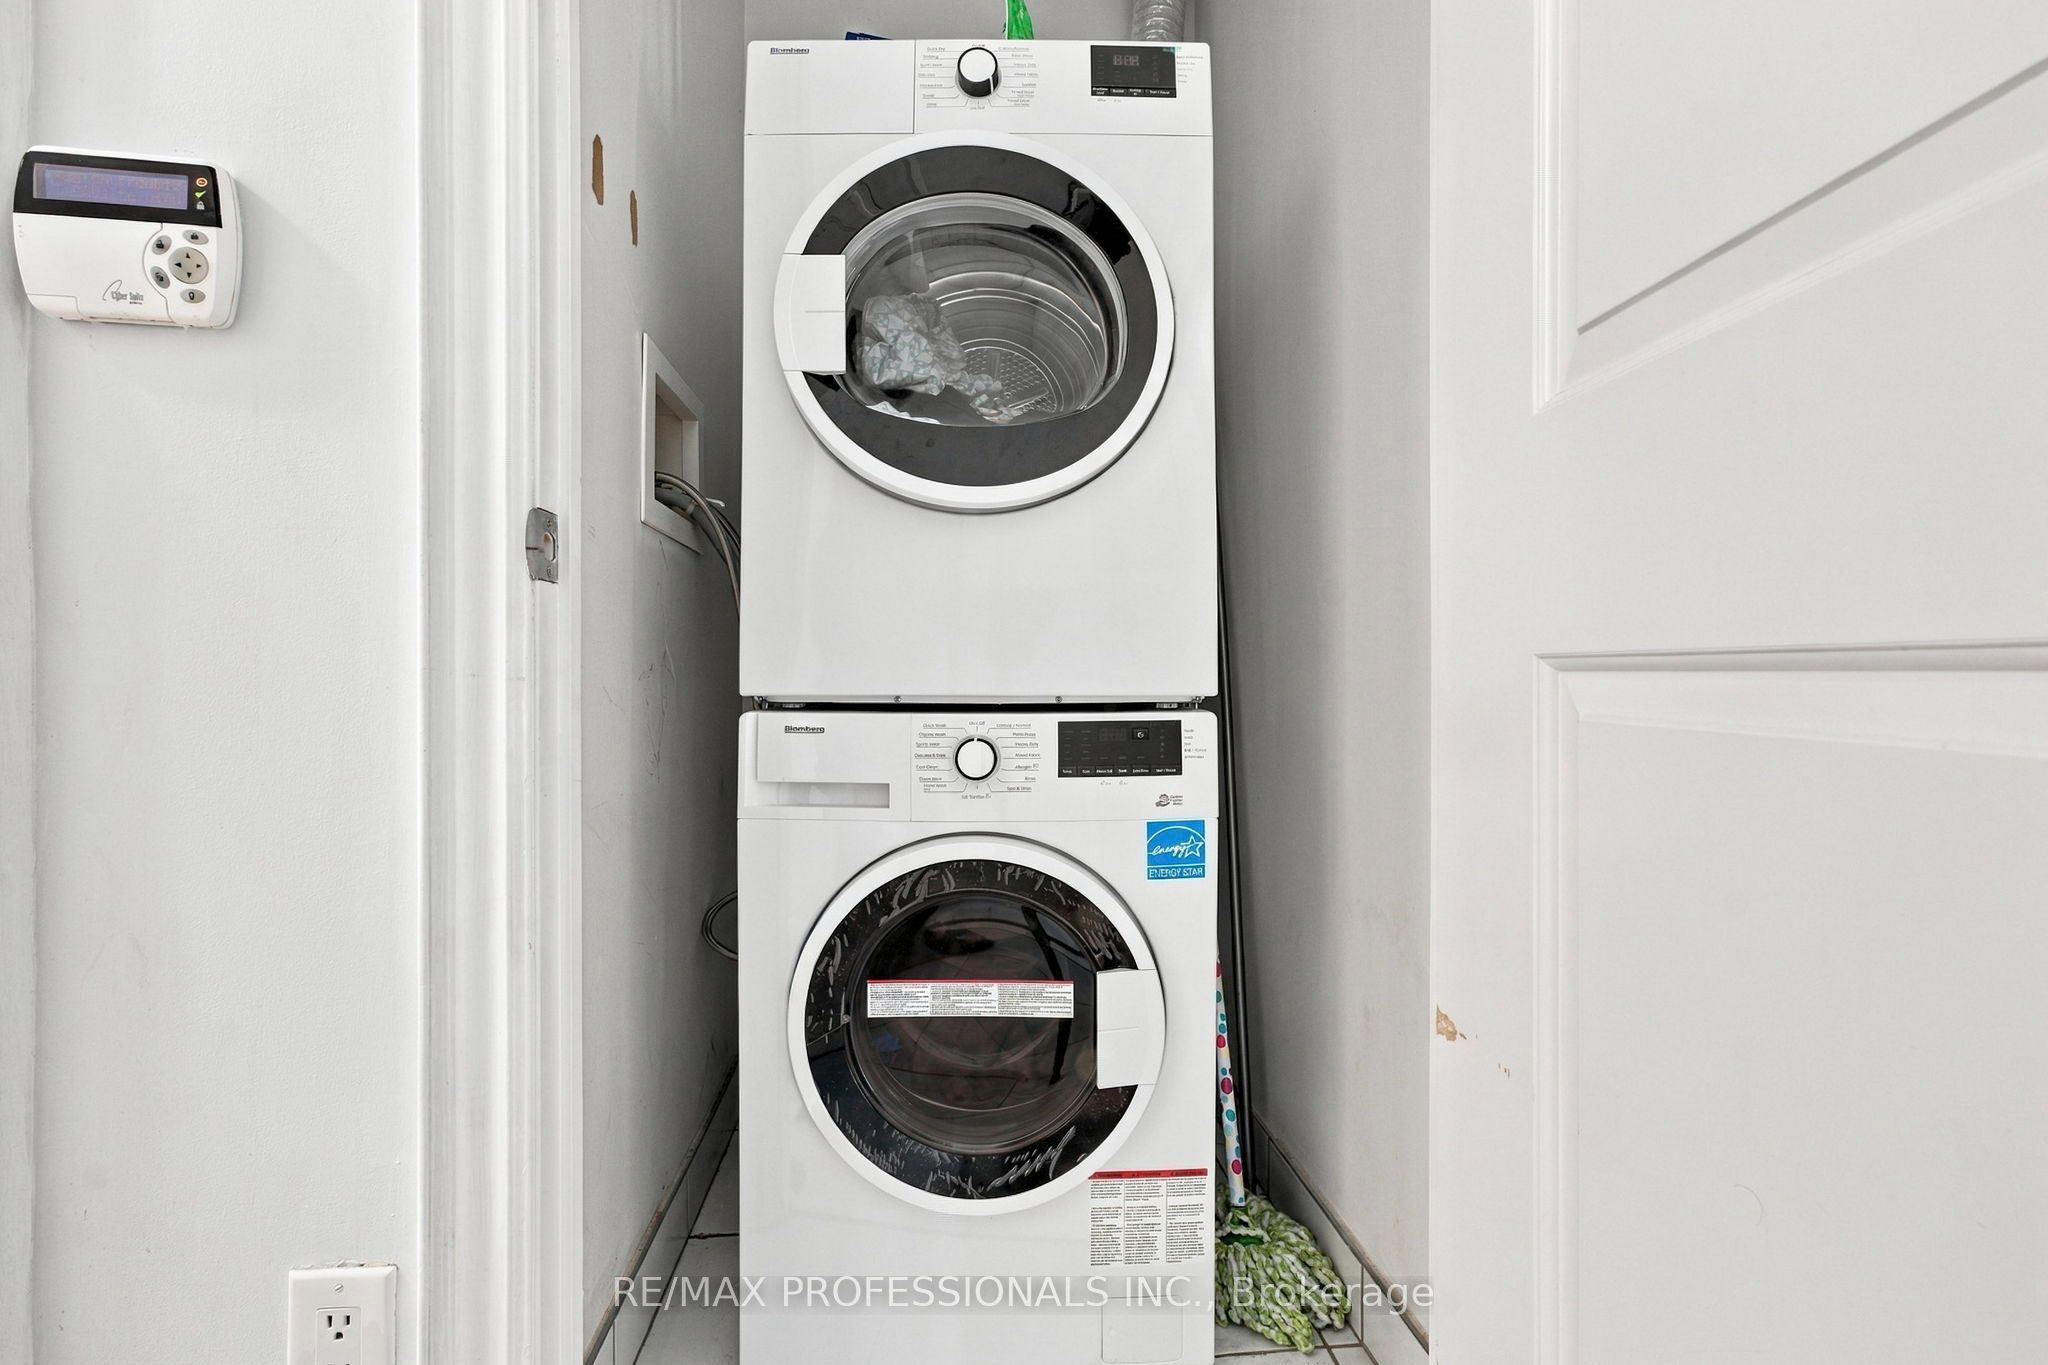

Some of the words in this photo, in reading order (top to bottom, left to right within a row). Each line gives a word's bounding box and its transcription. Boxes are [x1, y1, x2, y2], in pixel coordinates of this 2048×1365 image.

[784, 725, 825, 734] Blomberg
[1149, 868, 1181, 878] ENERGY
[1183, 867, 1203, 877] STAR
